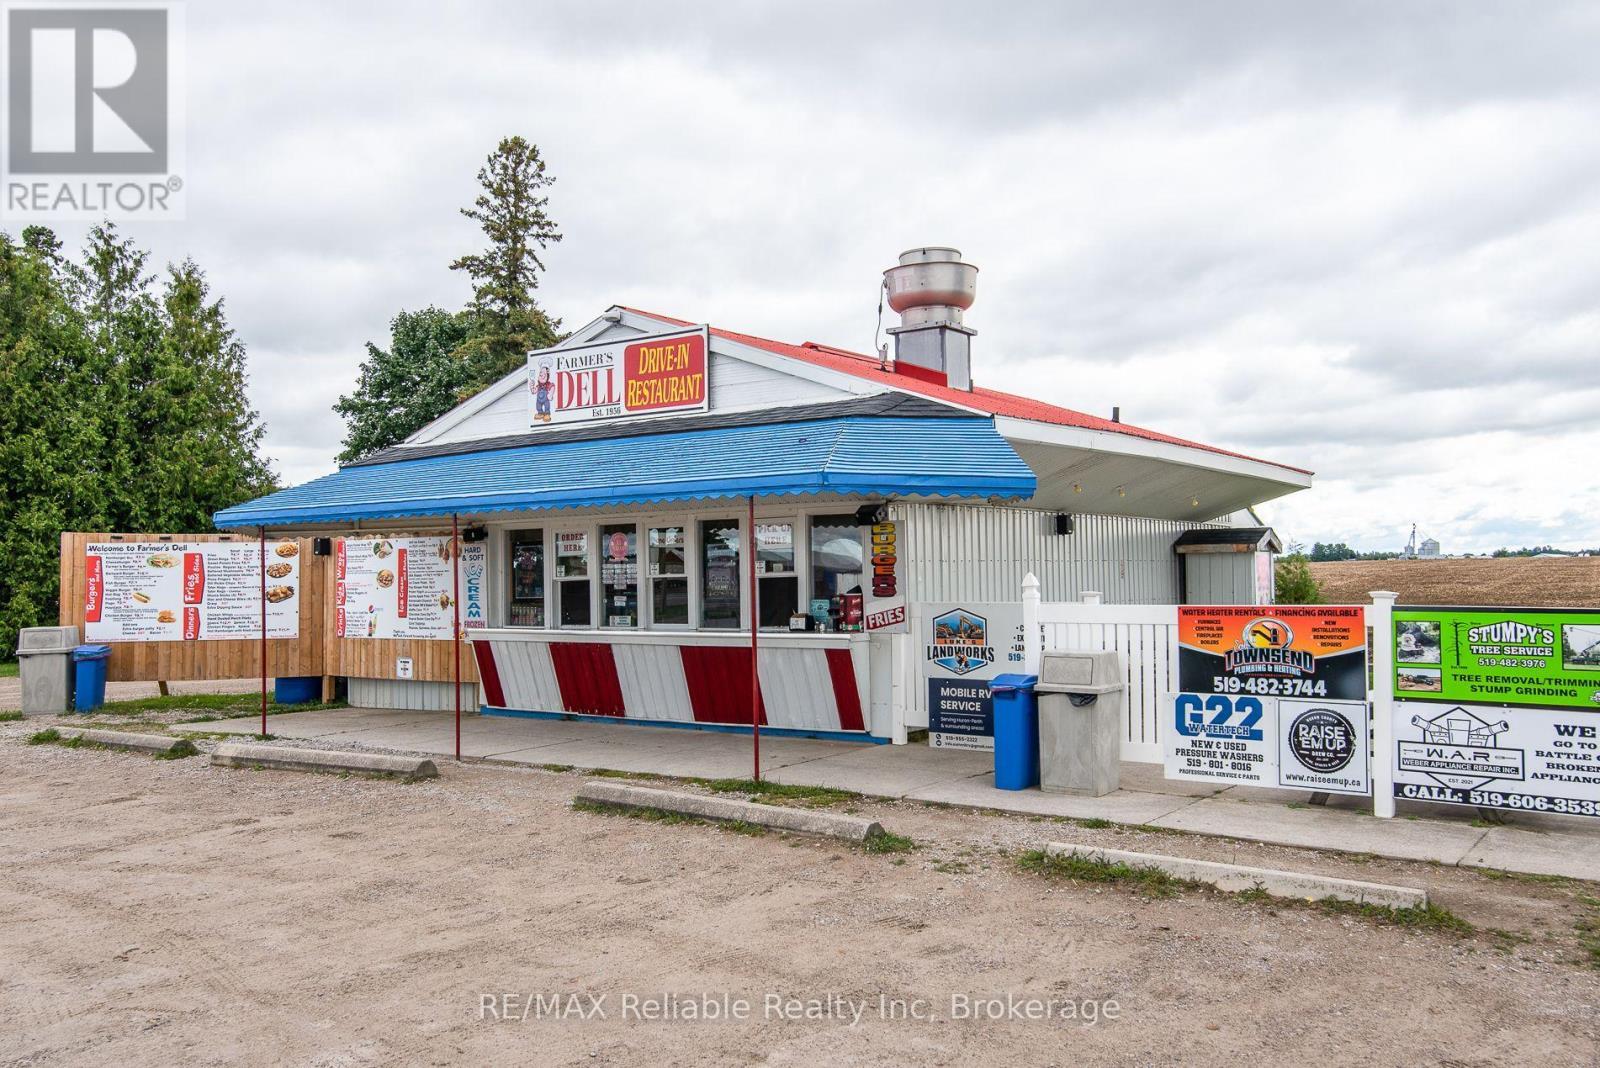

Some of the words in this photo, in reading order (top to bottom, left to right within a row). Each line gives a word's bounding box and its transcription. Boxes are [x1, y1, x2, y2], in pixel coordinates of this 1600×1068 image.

[557, 352, 614, 370] FARMER'S
[639, 343, 690, 374] DRIVE-IN
[556, 368, 621, 409] DELL
[627, 373, 703, 407] RESTAURANT
[561, 533, 585, 541] ORDER
[137, 544, 169, 552] Farmer's
[563, 544, 583, 552] HERE
[871, 522, 897, 598] BURGERS
[464, 563, 484, 578] ICE
[86, 577, 98, 611] Burgers
[185, 574, 195, 601] Fries
[467, 578, 481, 618] CREAM
[867, 608, 905, 628] FRIES
[1207, 609, 1233, 617] HEATER
[1234, 609, 1266, 617] RENTALS
[1275, 608, 1316, 617] FINANCING
[1317, 609, 1358, 617] AVAILABLE
[185, 607, 195, 639] Dinners
[464, 620, 485, 628] FROZEN
[1468, 620, 1555, 645] STUMPY'S
[927, 646, 995, 662] LANDWORKS
[1471, 645, 1500, 654] TREE
[1503, 646, 1552, 656] SERVICE
[1224, 647, 1316, 673] TOWNSEND
[1478, 658, 1546, 668] 519-482-3976
[1234, 663, 1266, 675] PLUMBING
[1267, 664, 1273, 672] &
[1274, 665, 1302, 676] HEATING
[1213, 676, 1328, 697] 519-482-3744
[1452, 674, 1482, 683] TREE
[1486, 675, 1600, 687] REMOVAL/TRIMMIN
[940, 687, 977, 698] MOBILE
[978, 689, 993, 699] RV
[1471, 684, 1512, 694] STUMP
[1515, 687, 1578, 697] GRINDING
[940, 700, 981, 711] SERVICE
[1175, 693, 1264, 741] G22
[1188, 724, 1250, 736] WATERTECH
[1298, 724, 1346, 740] RAISE
[1553, 724, 1596, 738] WE
[1191, 740, 1213, 749] NEW
[1215, 741, 1222, 749] &
[1224, 742, 1247, 751] USED
[1325, 738, 1347, 751] UP
[1553, 740, 1573, 748] GO
[1577, 742, 1598, 750] TO
[1175, 748, 1218, 759] PRESSURE
[1219, 751, 1264, 762] WASHERS
[1535, 750, 1592, 761] BATTLE
[1186, 758, 1202, 767] 519
[1208, 760, 1223, 769] 801
[1231, 762, 1252, 771] 8016
[1402, 758, 1429, 767] WEBER
[1430, 760, 1472, 770] APPLIANCE
[1473, 764, 1501, 773] REPAIR
[1179, 768, 1215, 776] PROFESSIONAL
[1216, 771, 1237, 779] SERVICE
[1286, 773, 1361, 788] www.raiseemup.ca
[1403, 785, 1463, 802] CALL:
